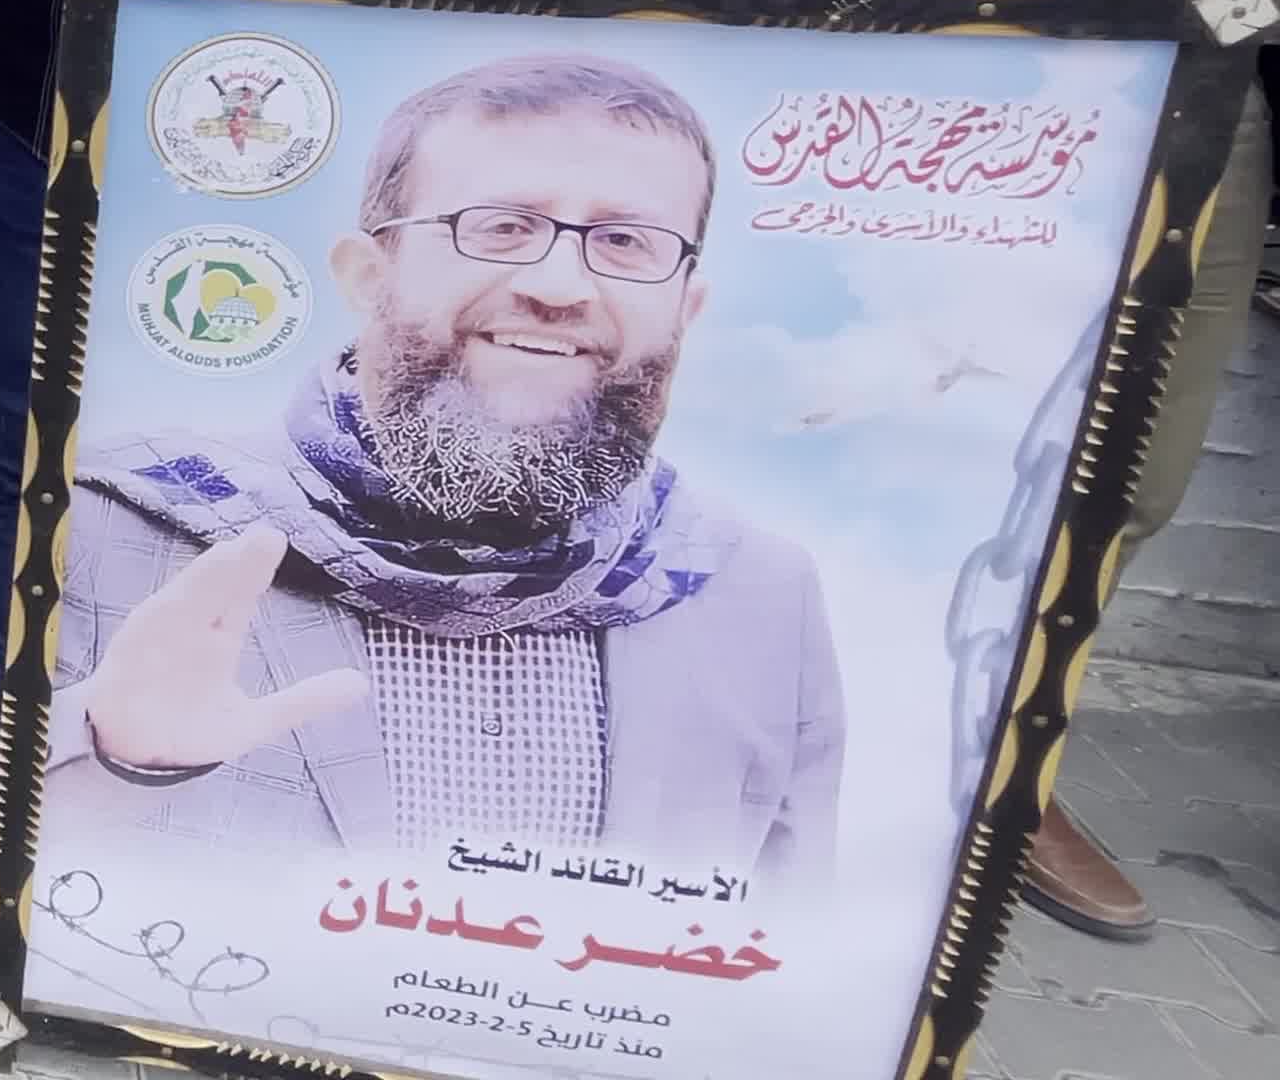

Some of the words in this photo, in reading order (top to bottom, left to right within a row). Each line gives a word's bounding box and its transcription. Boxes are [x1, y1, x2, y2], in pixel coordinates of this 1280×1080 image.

[742, 92, 882, 190] القدس
[136, 302, 170, 348] MUHJAT
[225, 315, 299, 367] FOUNDATION
[447, 836, 541, 876] الشيخ
[550, 855, 645, 889] القائد
[318, 876, 545, 950] عدنان
[554, 922, 783, 981] خضر
[392, 968, 499, 1001] الطعام
[507, 991, 574, 1014] عن
[582, 999, 672, 1027] مضرب
[536, 1023, 607, 1051] تاريخ
[612, 1036, 663, 1060] منذ
